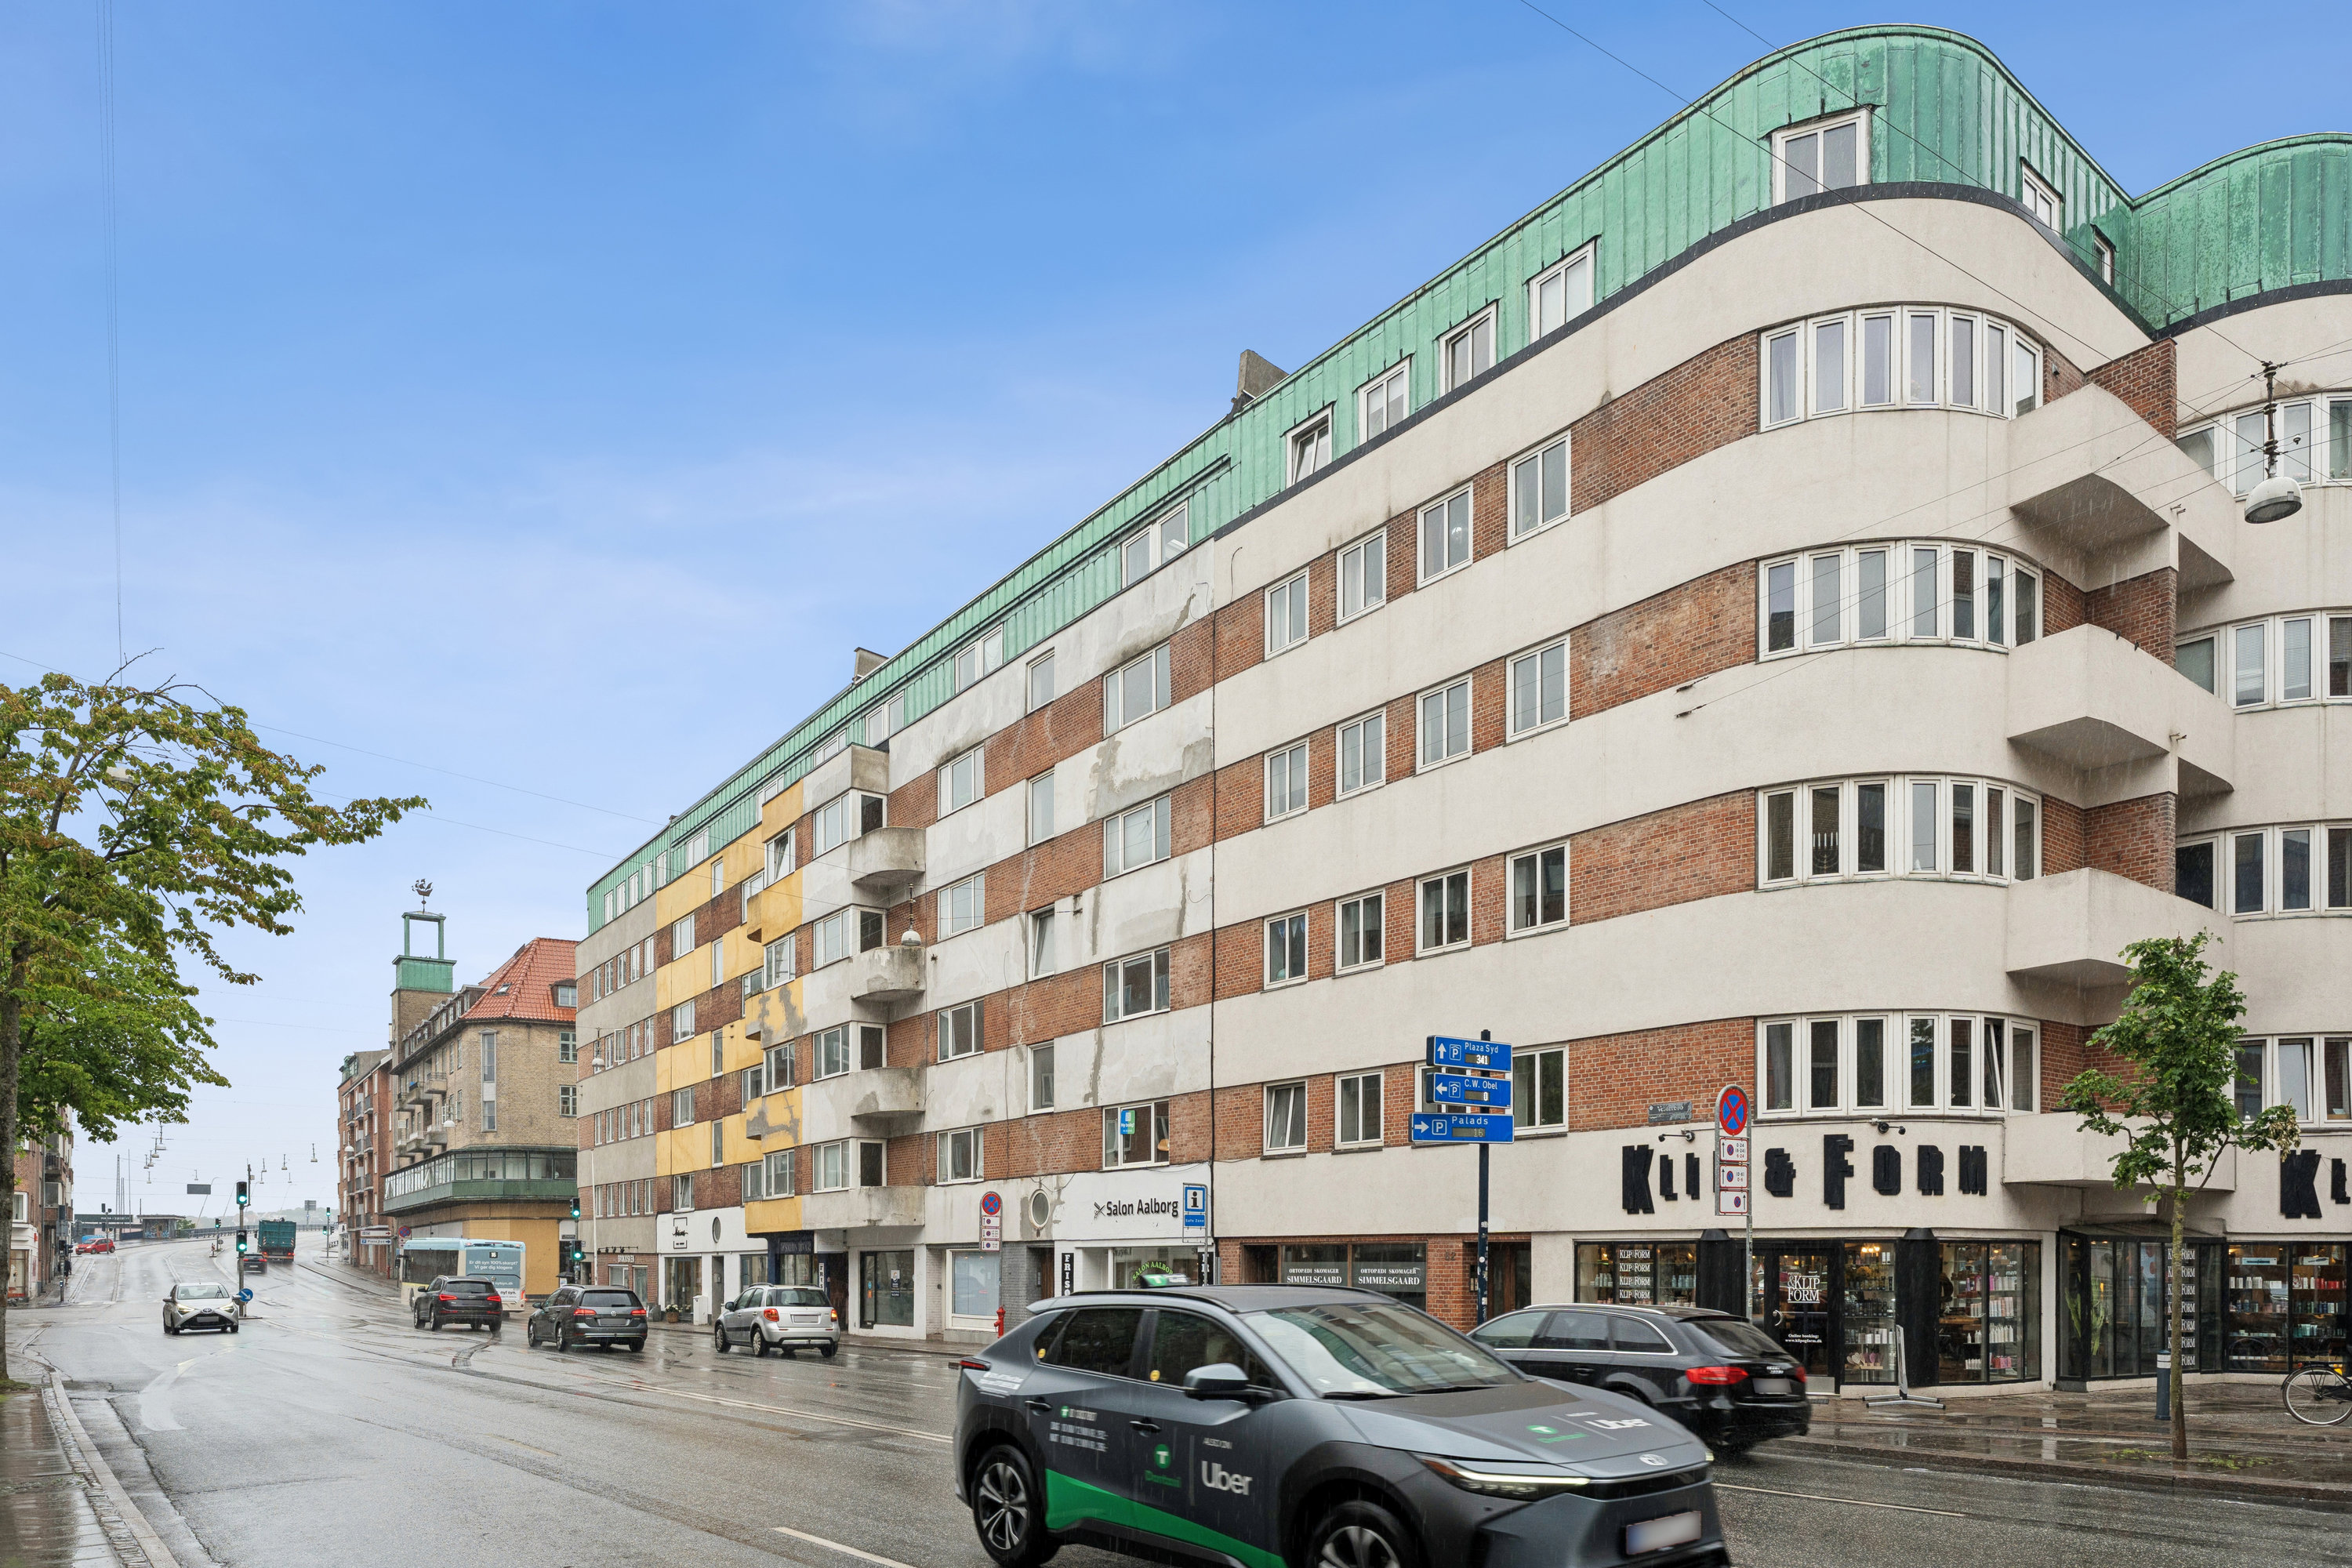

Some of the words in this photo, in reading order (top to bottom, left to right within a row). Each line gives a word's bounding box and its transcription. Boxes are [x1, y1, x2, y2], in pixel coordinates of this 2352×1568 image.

[1465, 1042, 1484, 1052] Plaza
[1486, 1044, 1498, 1054] Syd
[1465, 1079, 1480, 1088] C.W.
[1483, 1081, 1497, 1090] Obel
[1483, 1091, 1488, 1101] 0
[1451, 1116, 1488, 1125] Palads
[1622, 1144, 1715, 1214] KLI
[1764, 1147, 1796, 1197] &
[1824, 1134, 1987, 1210] FORM
[1106, 1200, 1134, 1216] Salon
[1137, 1198, 1178, 1218] Aalborg
[1619, 1250, 1632, 1258] KLIP
[1635, 1250, 1650, 1258] FORM
[2181, 1249, 2195, 1259] FORM
[1132, 1261, 1149, 1281] SALON
[1619, 1263, 1632, 1272] KLIP
[1635, 1263, 1650, 1272] FORM
[2181, 1266, 2195, 1277] FORM
[1287, 1276, 1342, 1284] SIMMELSGAARD
[1358, 1276, 1420, 1285] SIMMELSGAARD
[1619, 1276, 1632, 1285] KLIP
[1635, 1276, 1650, 1285] FORM
[1619, 1290, 1632, 1298] KLIP
[1635, 1290, 1650, 1298] FORM
[1788, 1287, 1820, 1301] FORM
[2181, 1283, 2195, 1294] FORM
[2181, 1301, 2195, 1312] FORM
[2181, 1319, 2195, 1330] FORM
[2181, 1337, 2195, 1348] FORM
[2181, 1354, 2195, 1366] FORM
[1201, 1461, 1253, 1496] Uber
